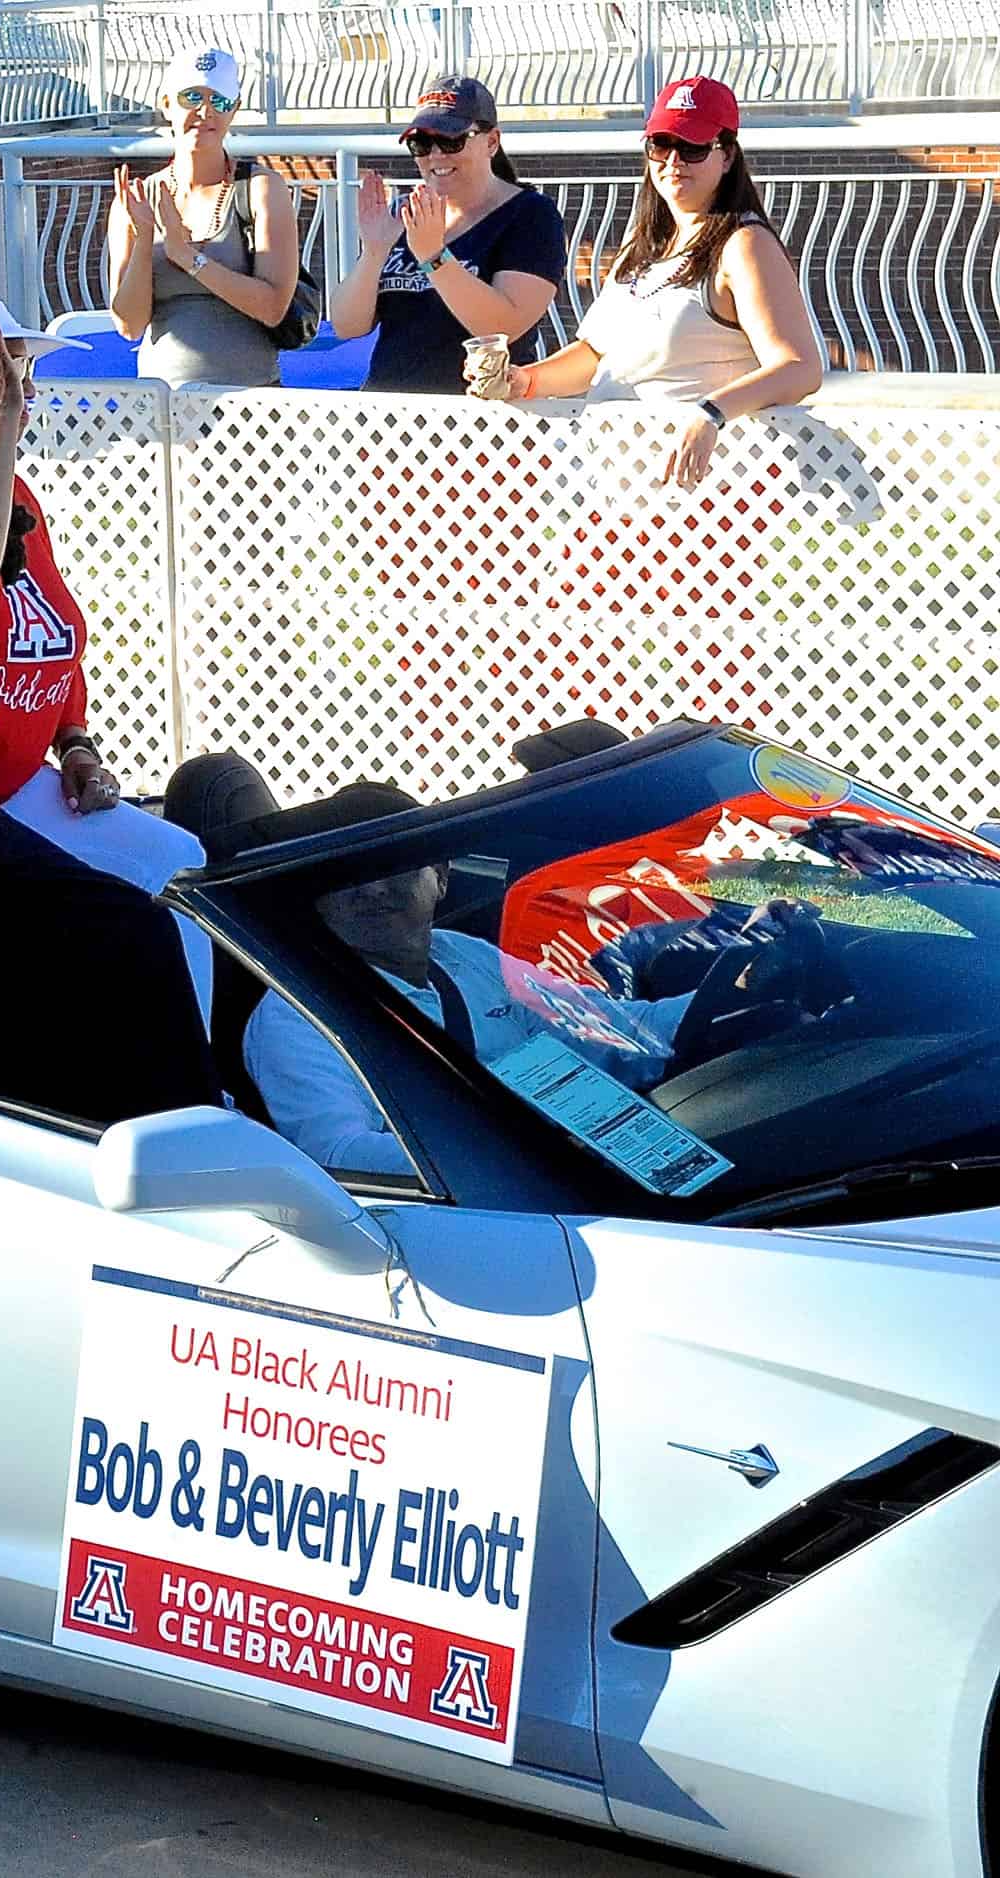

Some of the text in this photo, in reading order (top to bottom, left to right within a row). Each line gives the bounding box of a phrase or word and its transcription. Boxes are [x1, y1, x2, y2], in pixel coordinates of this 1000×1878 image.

[7, 568, 76, 663] A
[170, 1323, 454, 1423] UA Black Alumni
[223, 1392, 387, 1465] Honorees
[75, 1417, 524, 1610] Bob & Beverly Elliott
[71, 1557, 135, 1633] A
[159, 1573, 414, 1665] HOMECOMING
[158, 1611, 412, 1703] CELEBRATION
[429, 1648, 499, 1727] A
